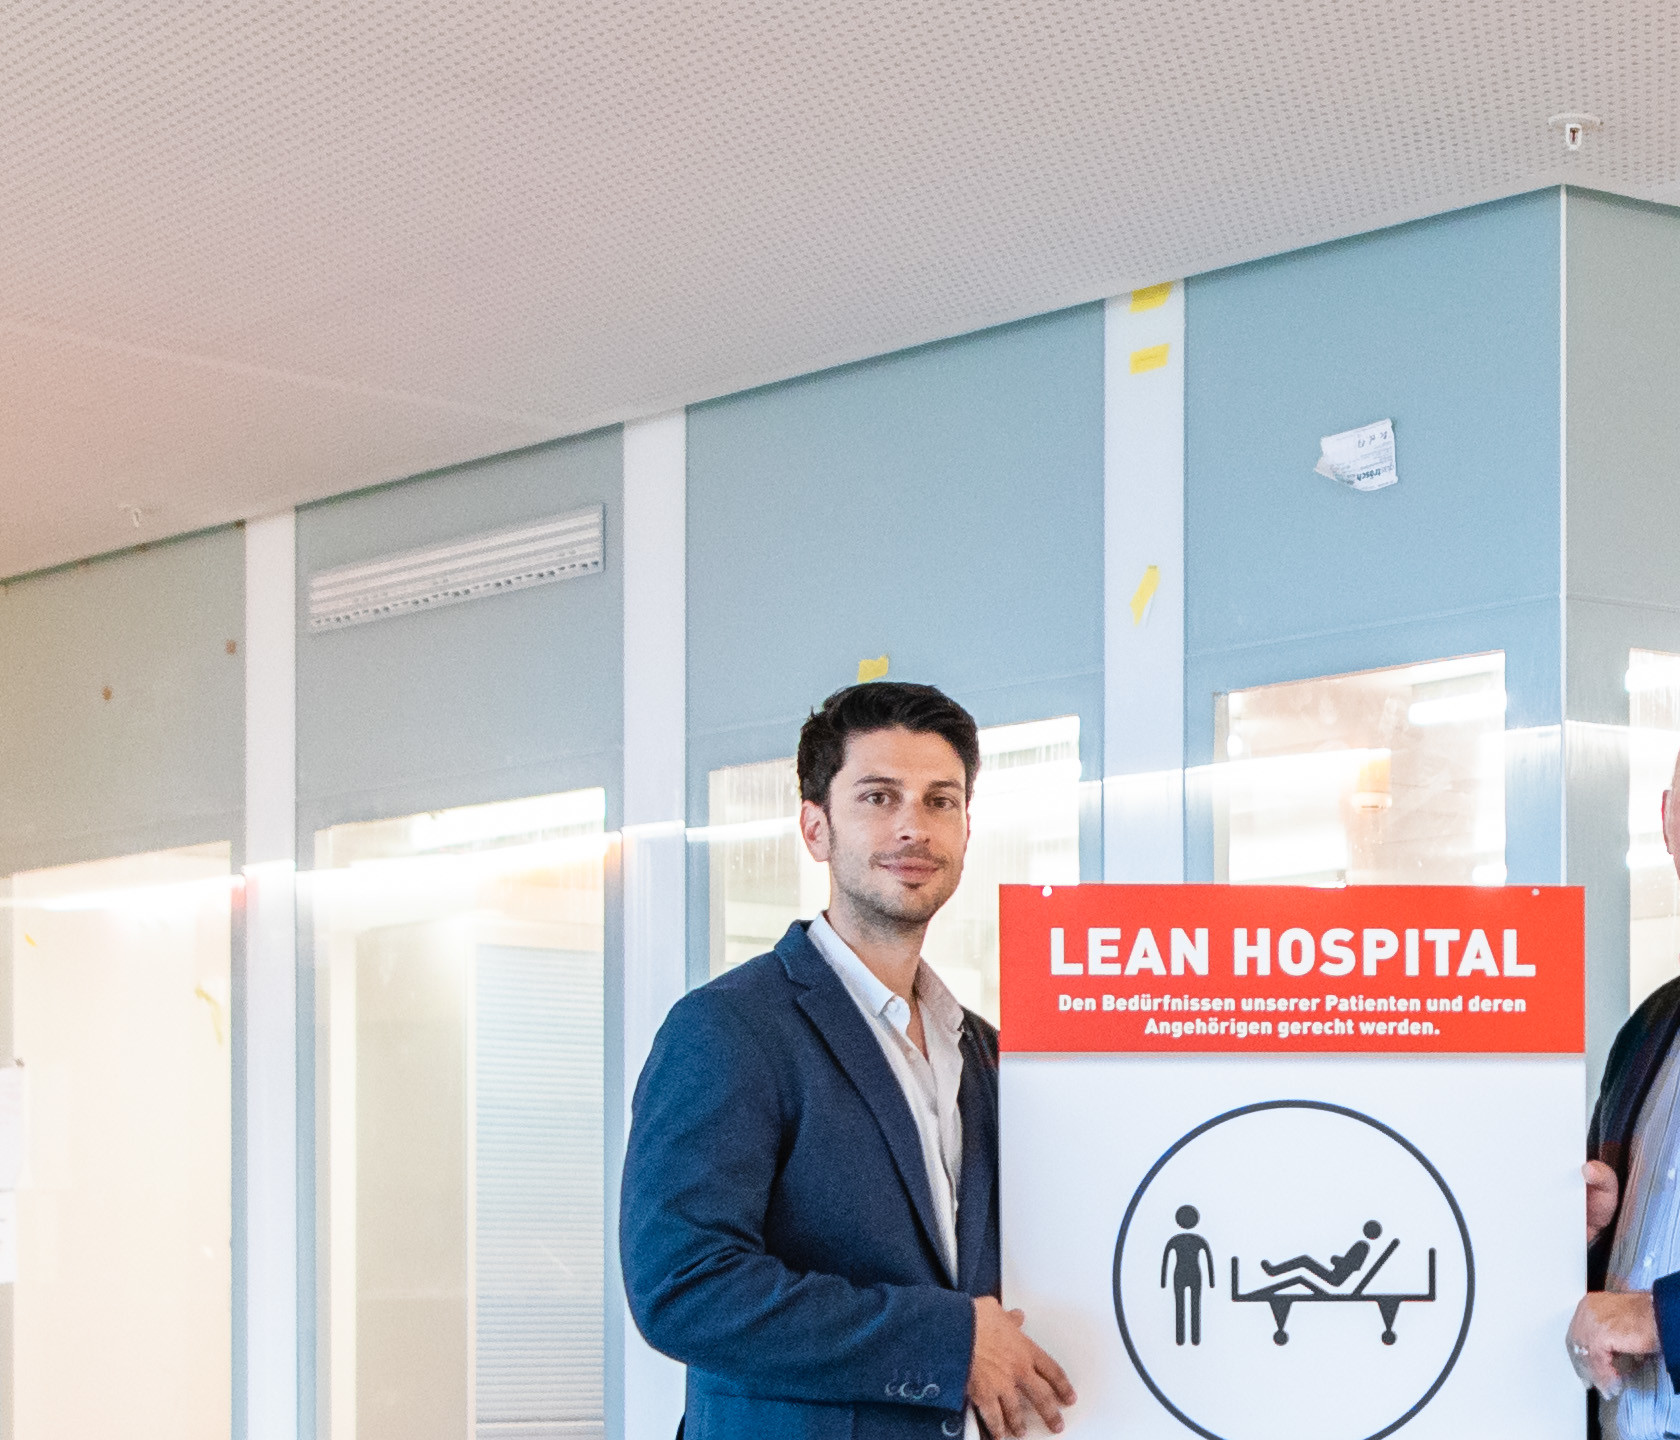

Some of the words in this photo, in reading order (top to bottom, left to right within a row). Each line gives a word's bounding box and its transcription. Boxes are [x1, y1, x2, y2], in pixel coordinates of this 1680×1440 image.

[1051, 928, 1209, 976] LEAN
[1234, 928, 1537, 978] HOSPITAL
[1059, 995, 1097, 1012] Den
[1102, 994, 1236, 1012] Bedürfnissen
[1241, 998, 1321, 1012] unserer
[1326, 995, 1421, 1012] Patienten
[1426, 996, 1463, 1013] und
[1468, 996, 1527, 1013] deren
[1145, 1018, 1273, 1039] Angehörigen
[1278, 1018, 1355, 1039] gerecht
[1360, 1019, 1441, 1036] werden.
